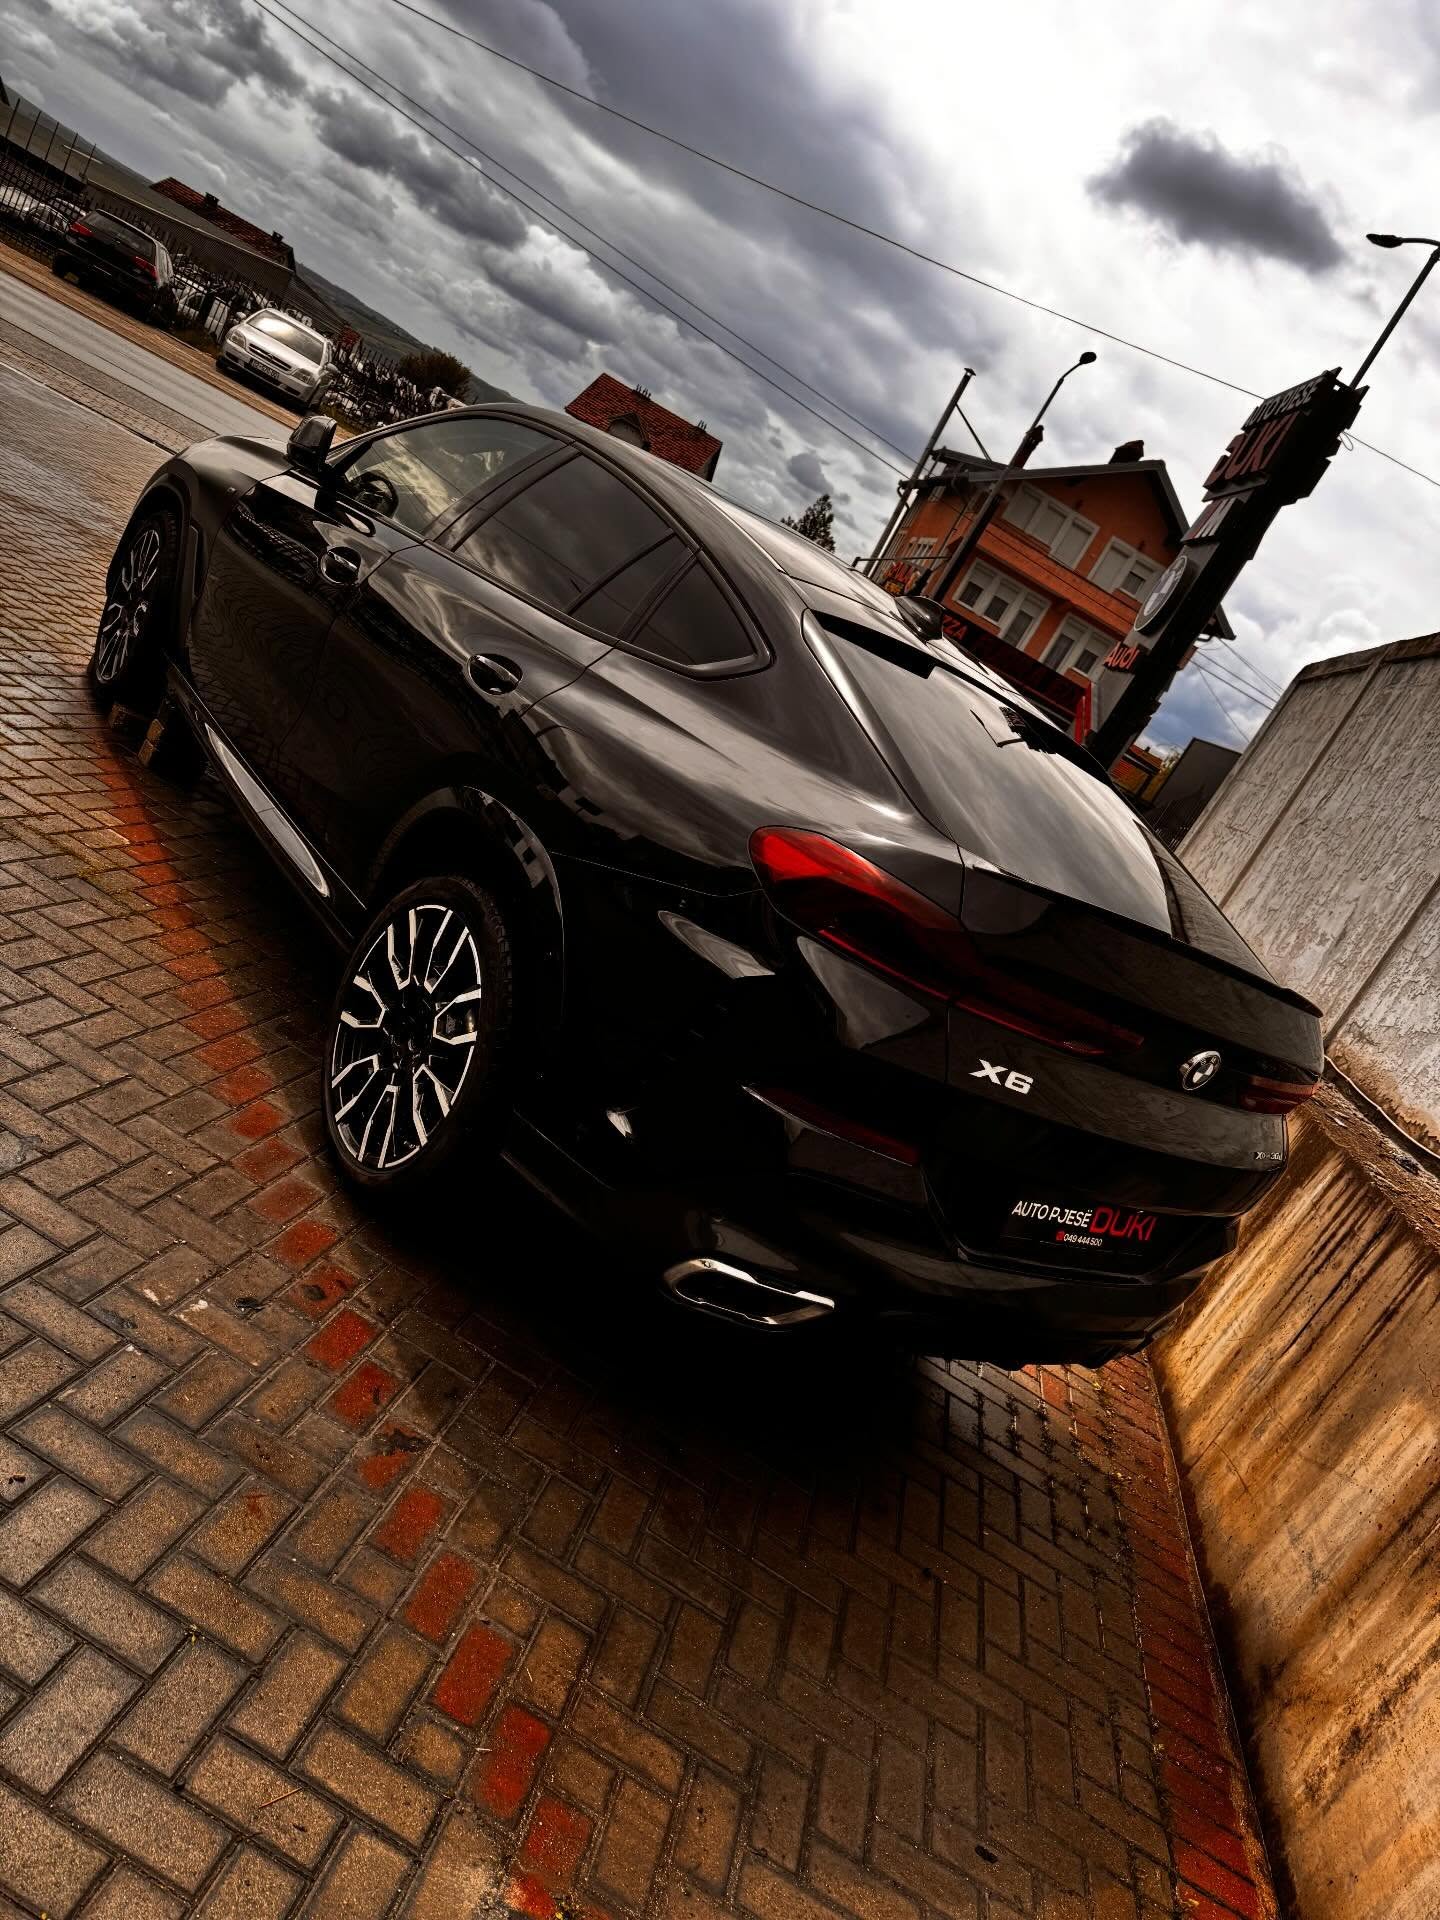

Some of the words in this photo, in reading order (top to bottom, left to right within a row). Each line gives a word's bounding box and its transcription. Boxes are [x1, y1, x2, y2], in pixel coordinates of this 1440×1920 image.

[968, 1059, 1034, 1094] X6
[1011, 1200, 1047, 1220] AUTO
[1048, 1206, 1093, 1227] PJESË
[1089, 1206, 1159, 1241] DUKI
